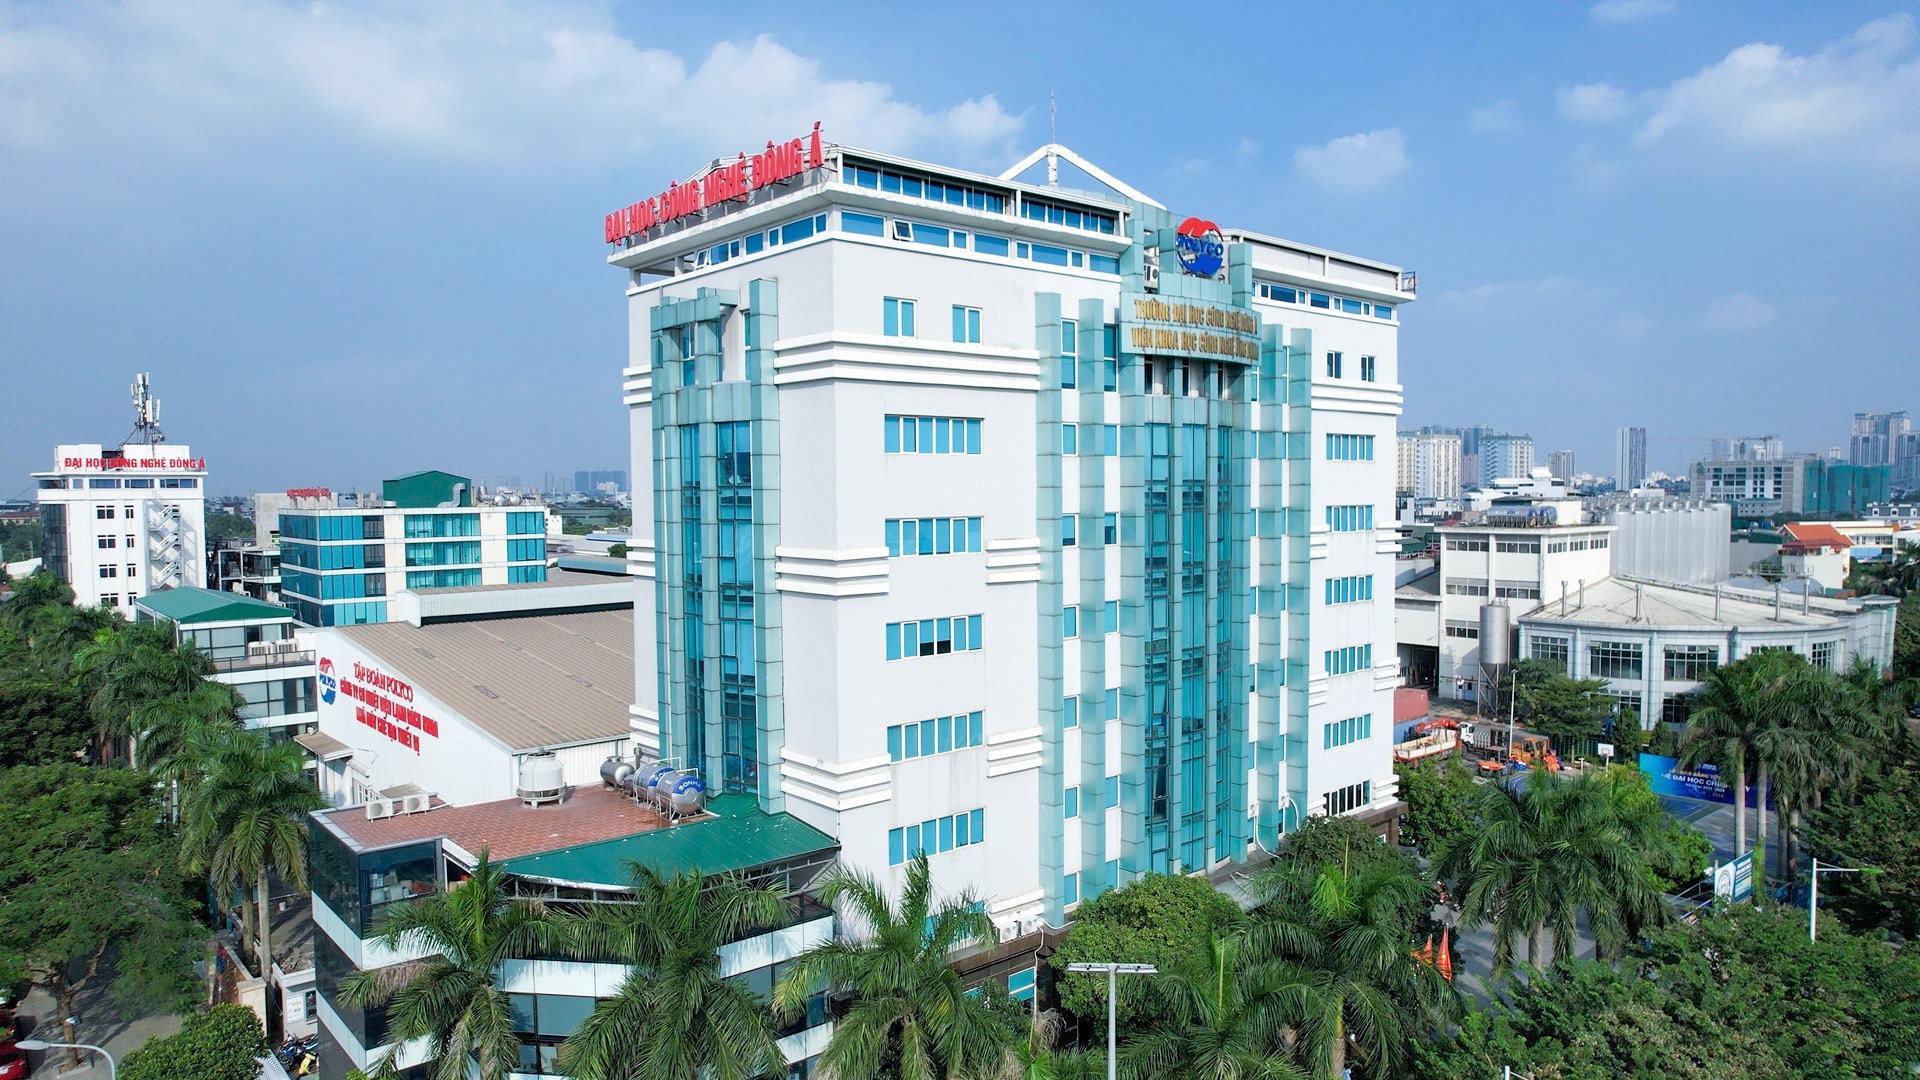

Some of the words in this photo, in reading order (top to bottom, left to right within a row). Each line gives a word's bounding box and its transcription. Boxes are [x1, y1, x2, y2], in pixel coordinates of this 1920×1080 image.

[604, 208, 629, 246] ĐẠI
[629, 196, 657, 237] HỌC
[659, 180, 701, 223] CÔNG
[703, 151, 749, 203] NGHỆ
[752, 137, 805, 190] ĐÔNG
[809, 120, 825, 169] Á
